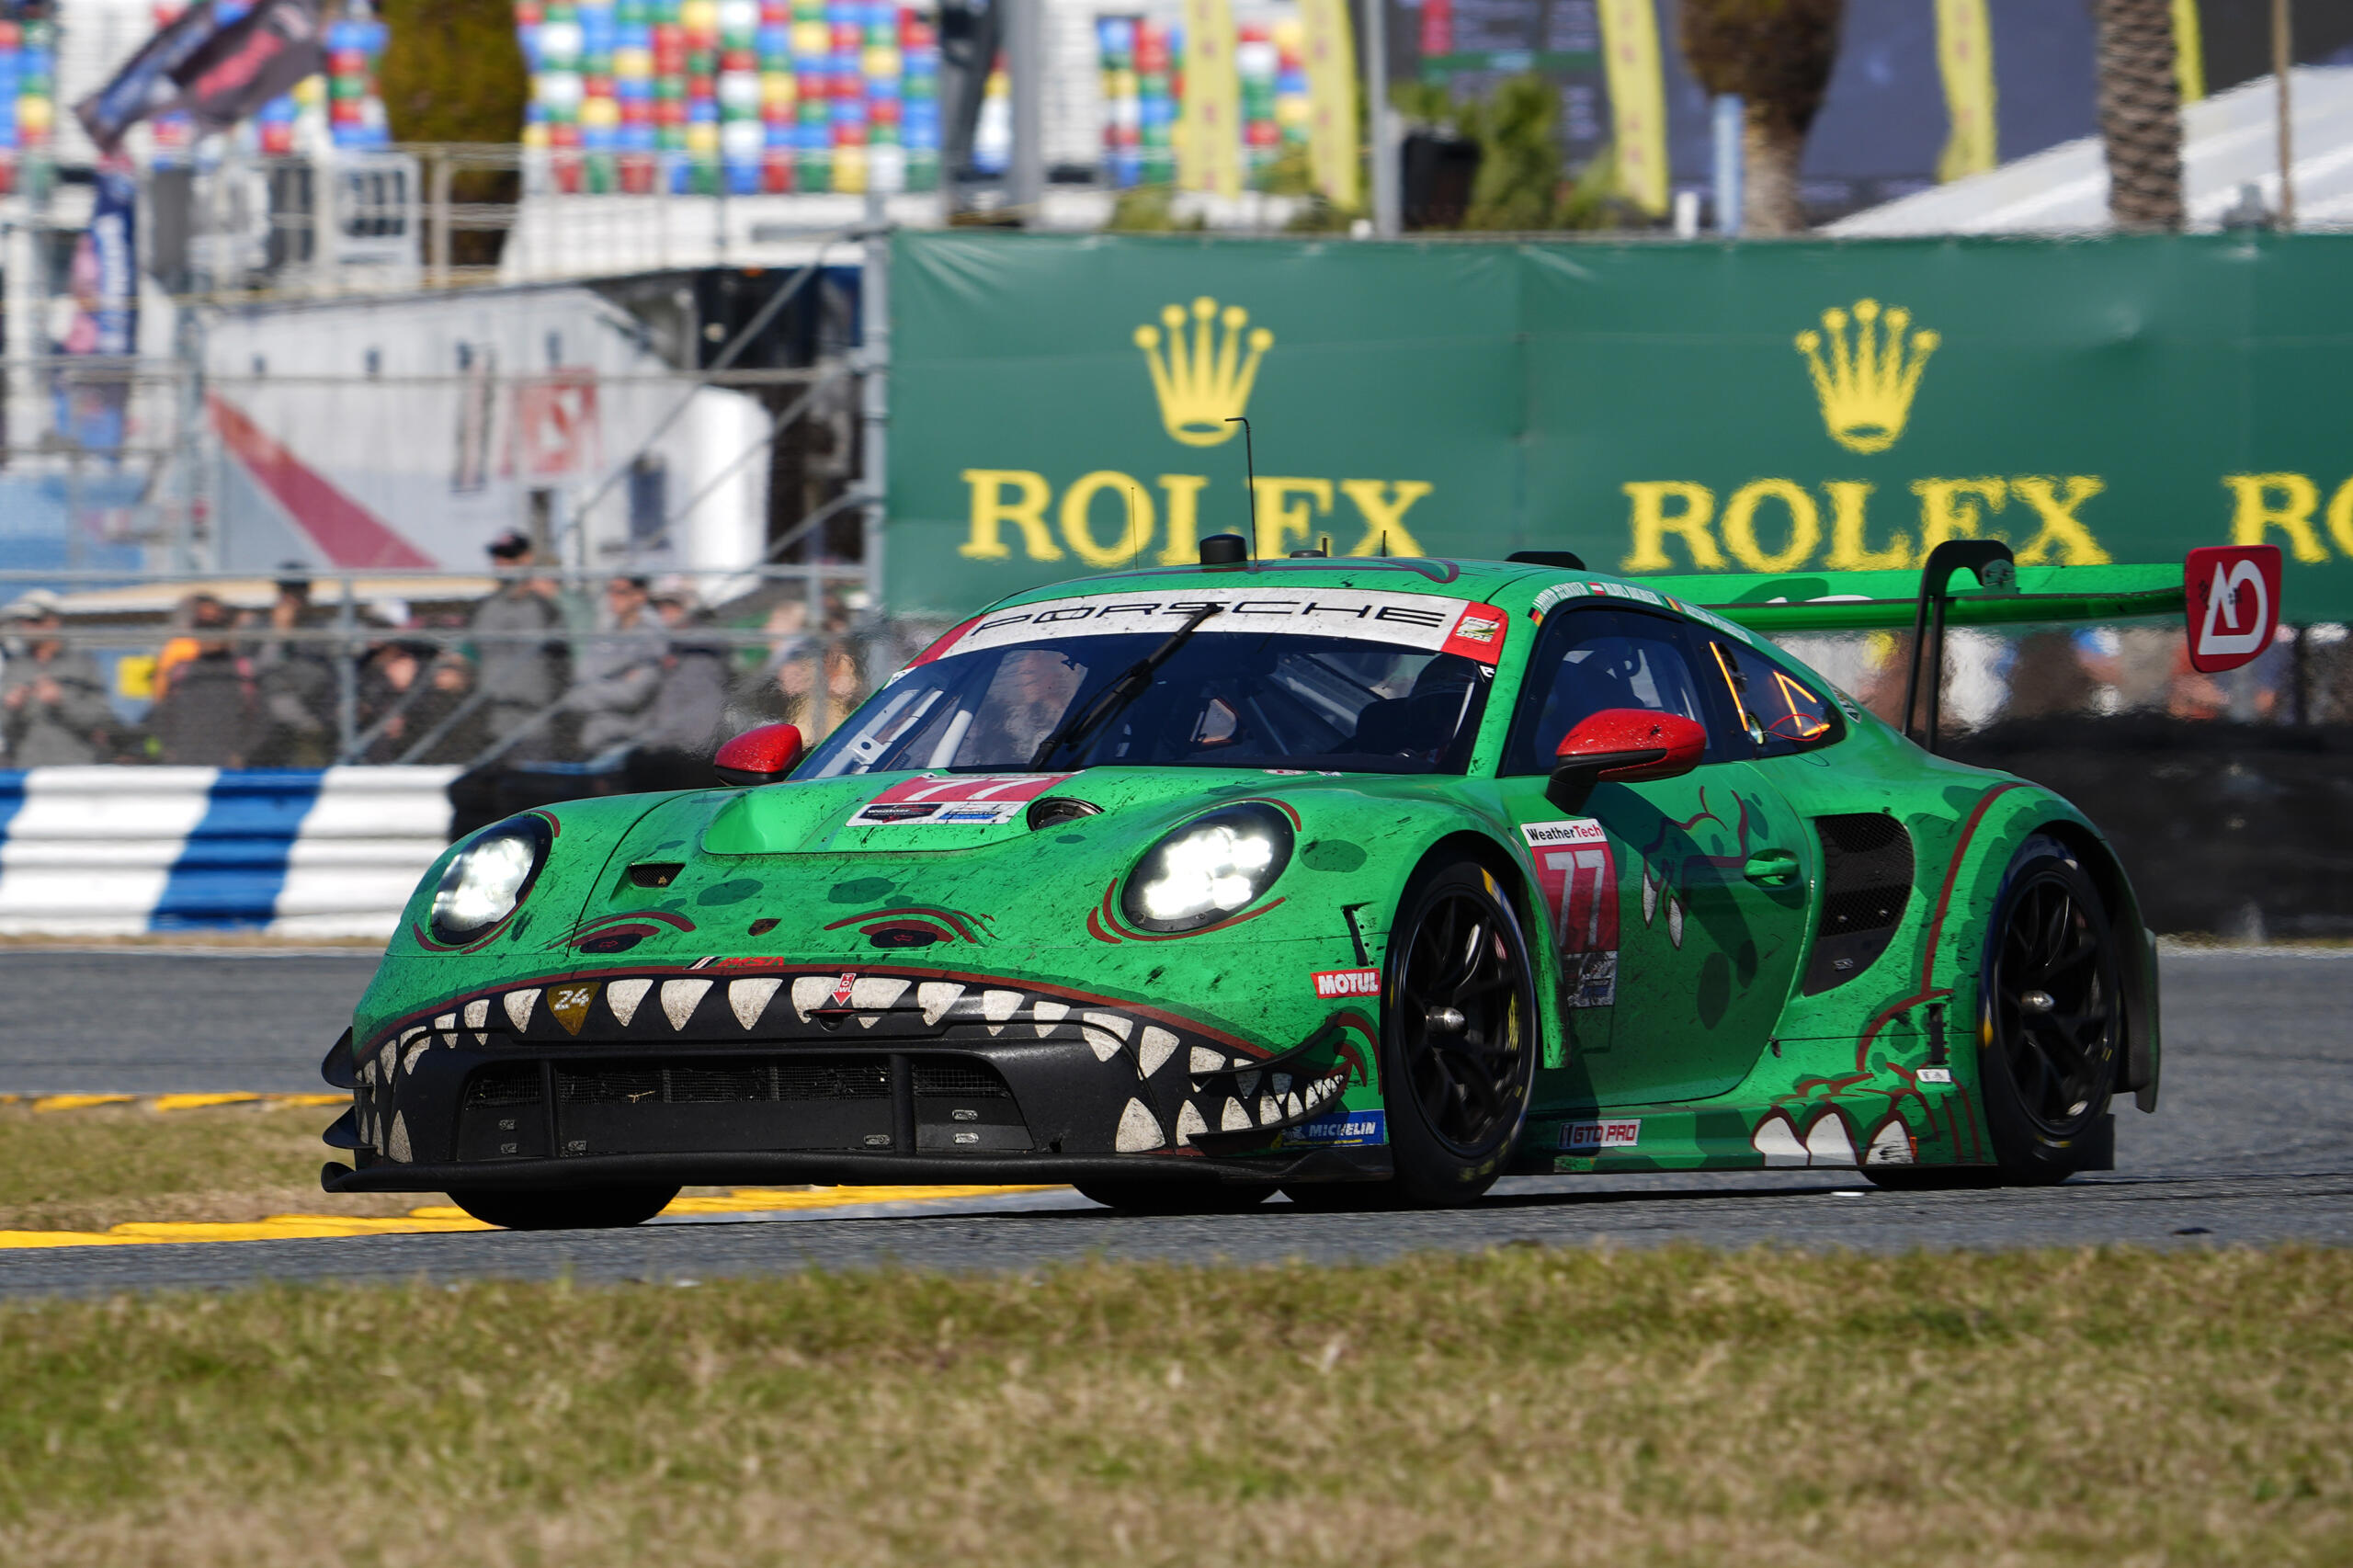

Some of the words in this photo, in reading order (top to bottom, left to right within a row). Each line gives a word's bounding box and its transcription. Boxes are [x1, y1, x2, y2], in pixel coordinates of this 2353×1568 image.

[958, 469, 1434, 567] ROLEX
[1620, 473, 2112, 572] ROLEX
[2221, 472, 2353, 565] R
[971, 599, 1446, 637] PORSCHE
[903, 777, 1051, 801] 77
[1527, 824, 1604, 842] WeatherTech
[1543, 849, 1606, 948] 77
[715, 956, 784, 968] IMSA
[837, 974, 855, 993] TOW
[1317, 971, 1379, 994] MOTUL
[553, 988, 589, 1012] 24
[1309, 1121, 1377, 1137] MICHELIN
[1574, 1125, 1604, 1143] GTD
[1605, 1124, 1637, 1142] PRO
